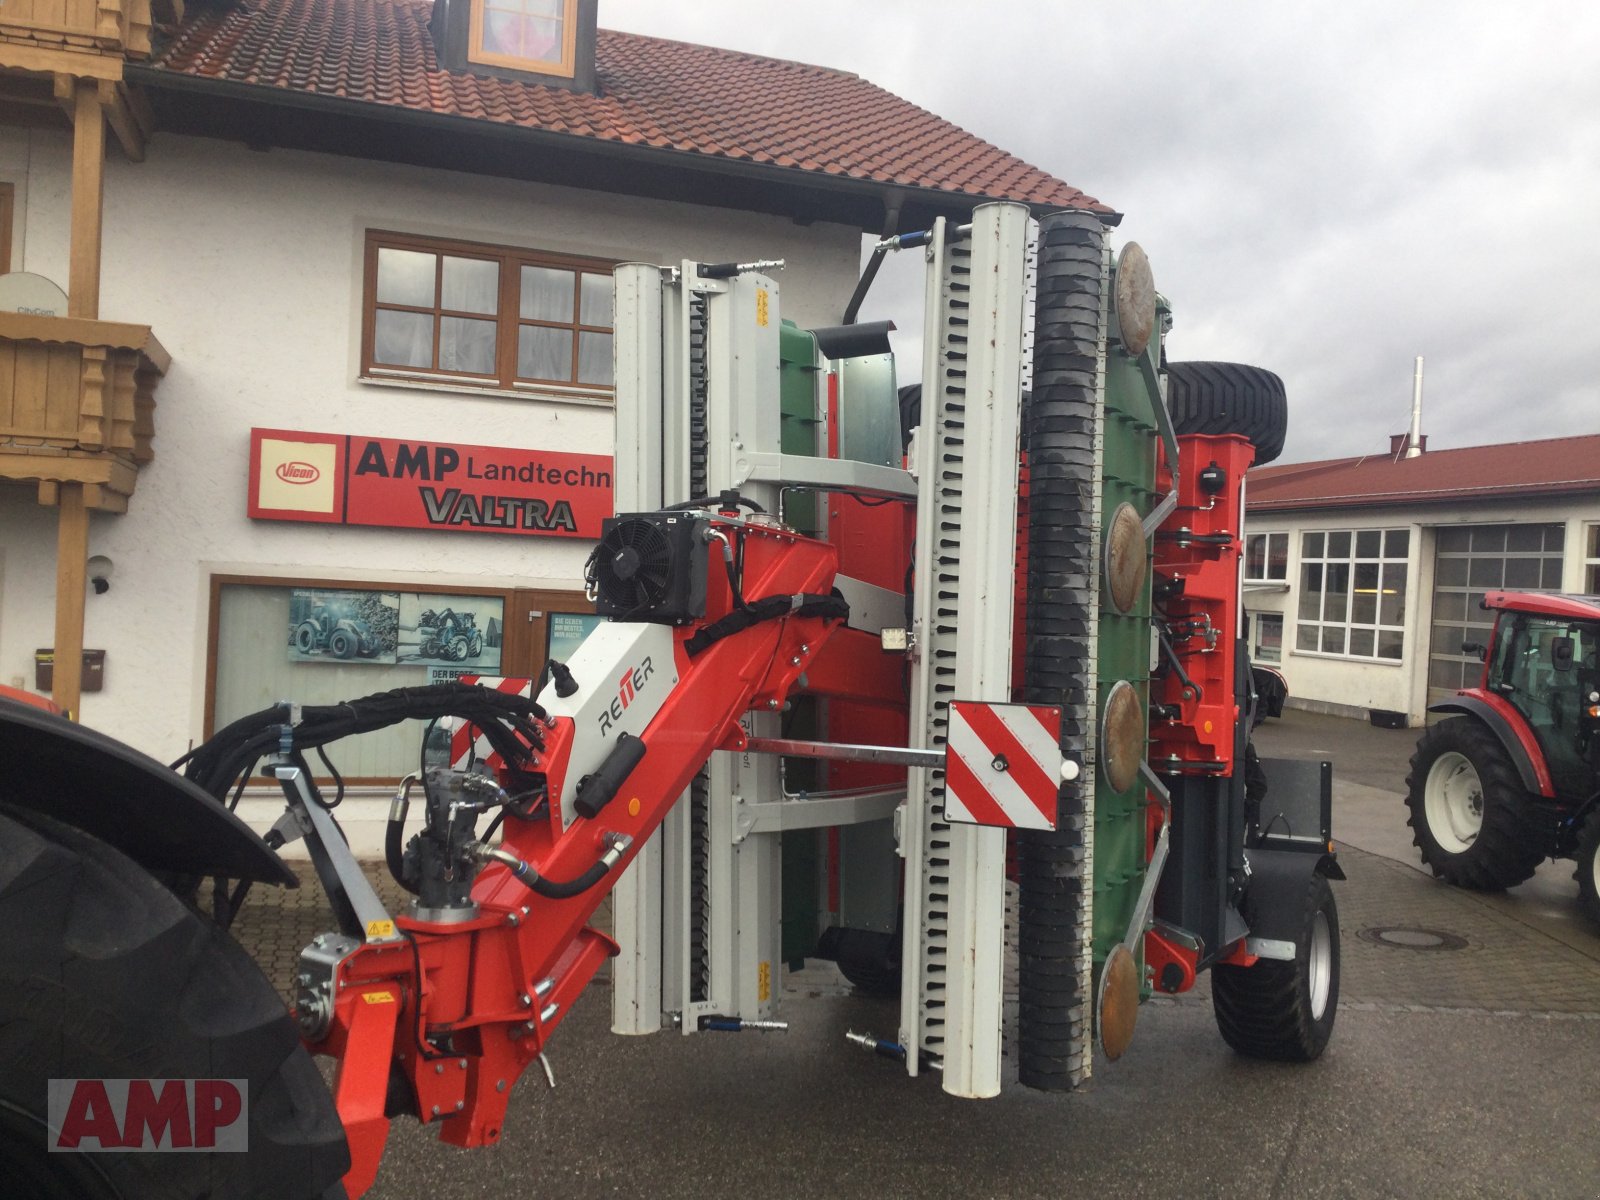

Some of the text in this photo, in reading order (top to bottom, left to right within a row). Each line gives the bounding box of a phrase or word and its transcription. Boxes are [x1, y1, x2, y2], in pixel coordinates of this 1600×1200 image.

[281, 462, 315, 479] Vicon
[355, 441, 460, 482] AMP
[418, 486, 578, 532] VALTRA
[432, 669, 448, 678] DER
